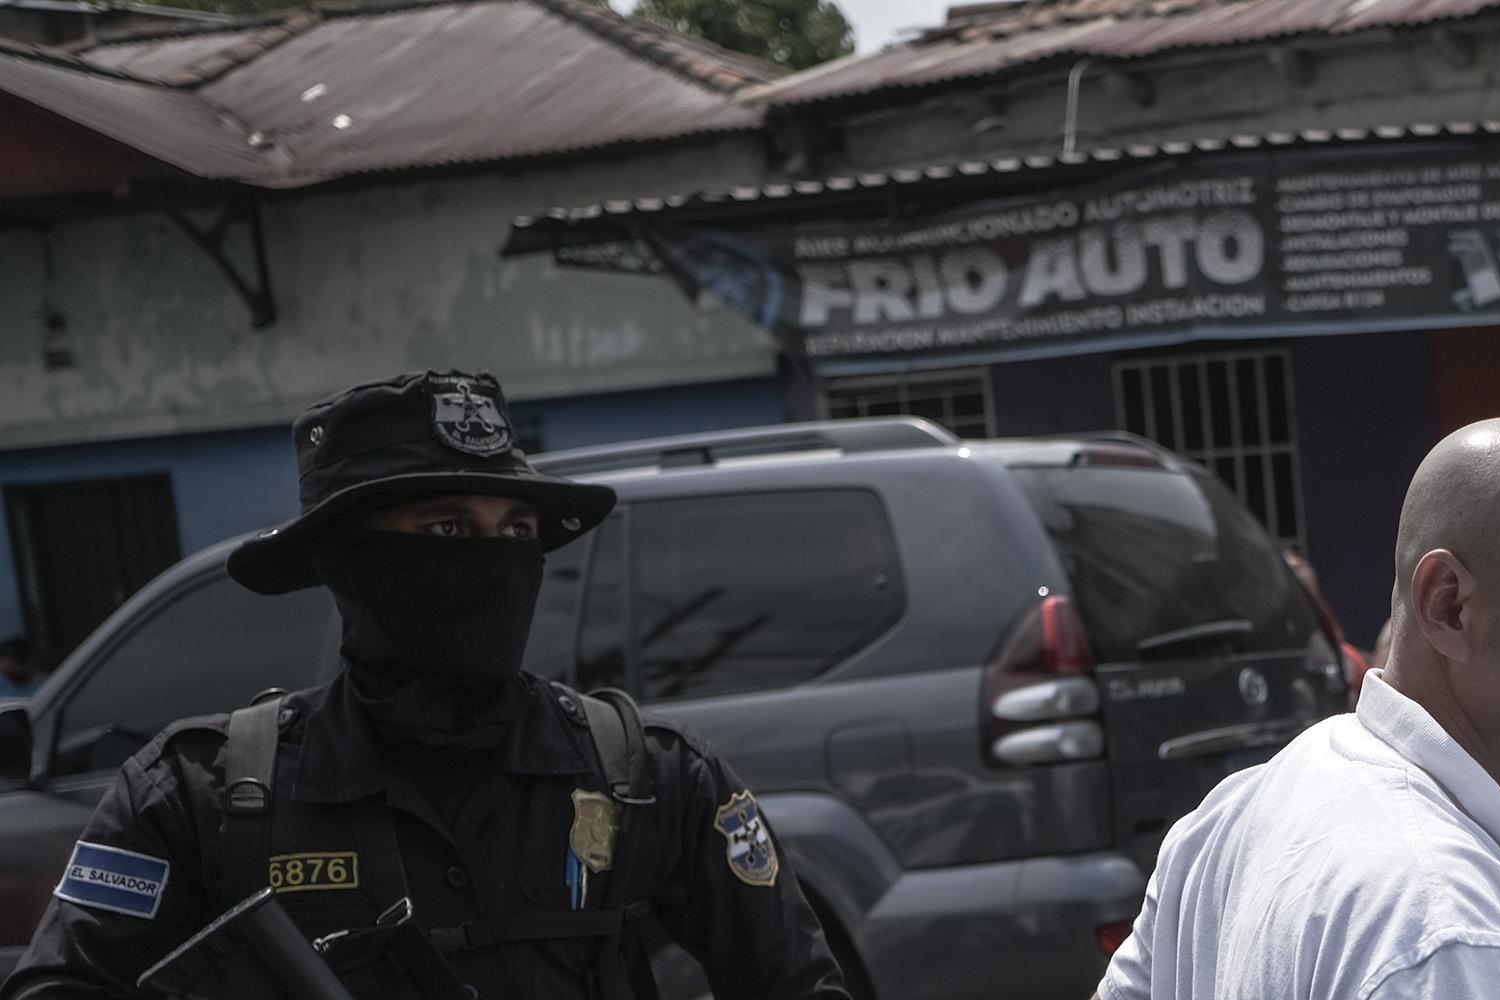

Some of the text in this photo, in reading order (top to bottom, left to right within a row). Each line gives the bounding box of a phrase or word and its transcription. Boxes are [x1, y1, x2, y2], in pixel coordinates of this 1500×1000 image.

[797, 209, 1265, 327] FRIO AUTO
[70, 866, 157, 895] EL SALVADOR
[268, 857, 348, 888] 6876
